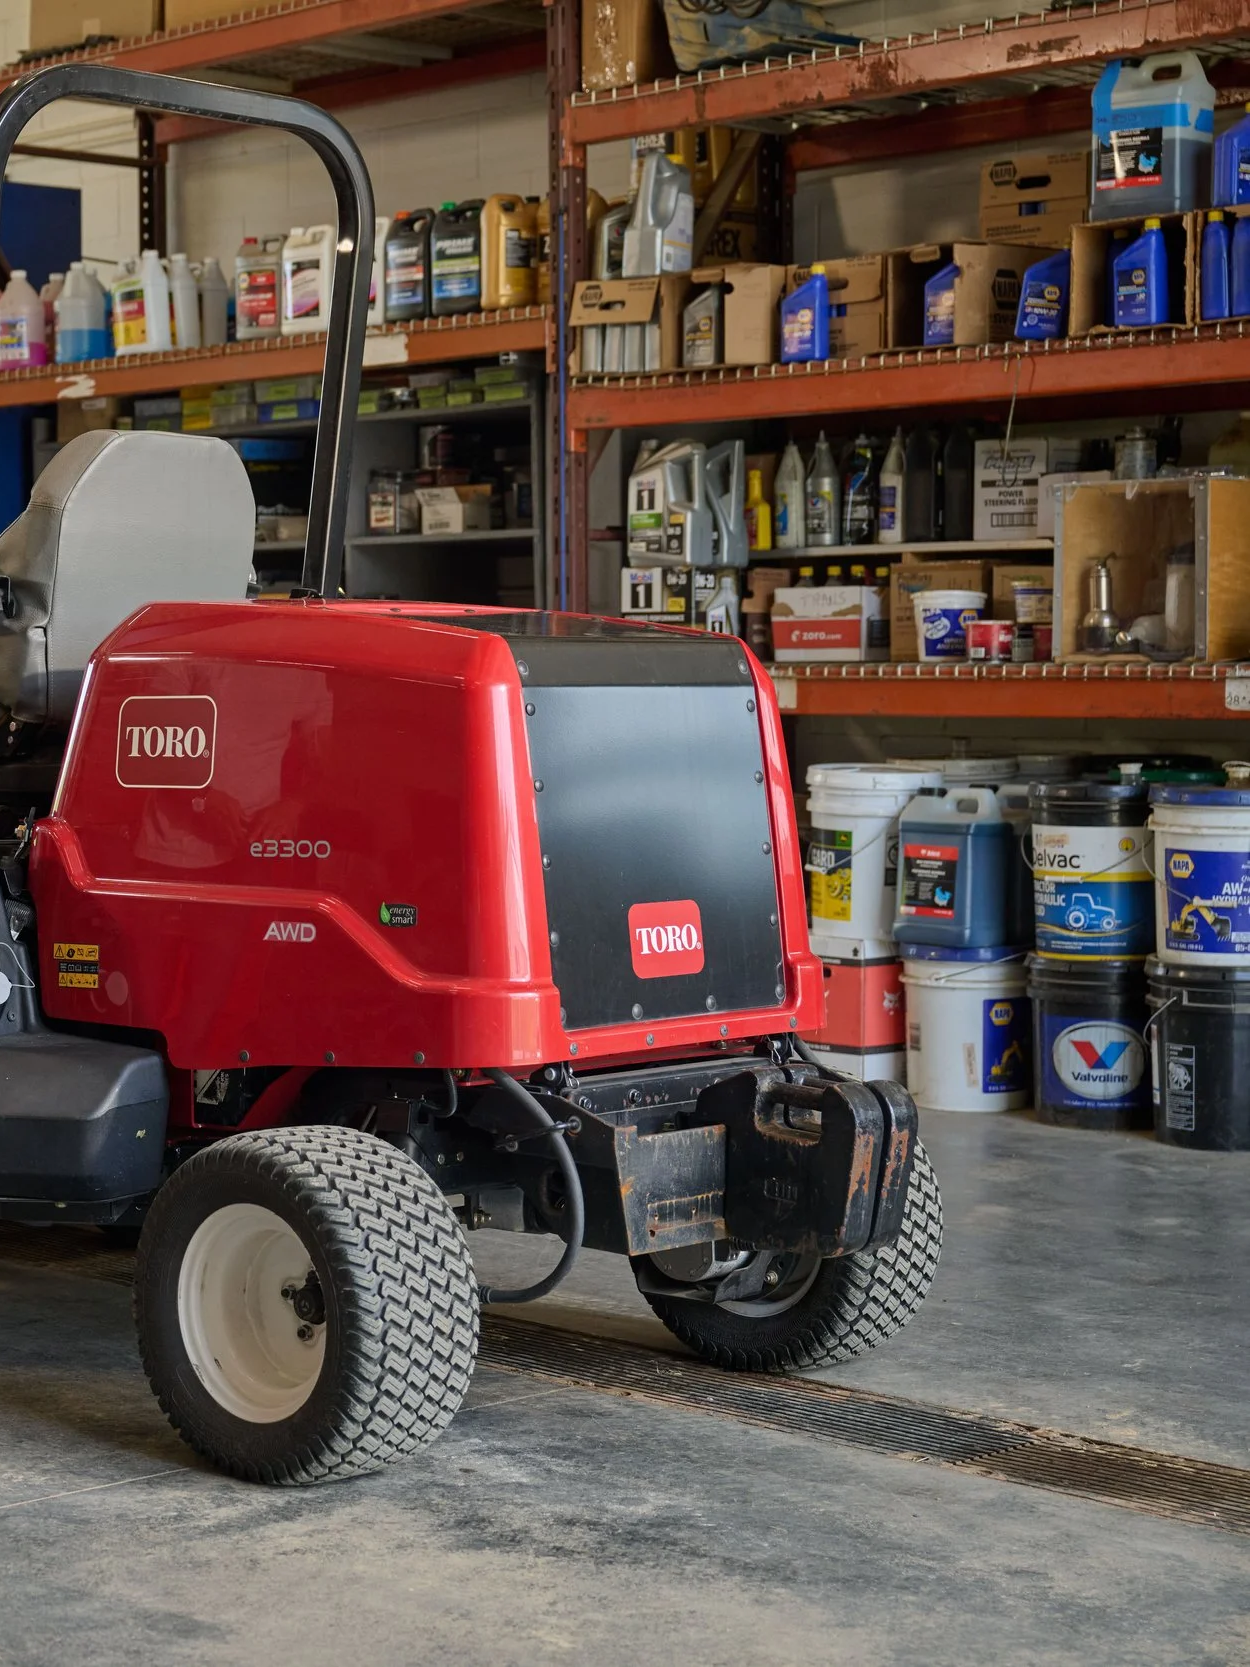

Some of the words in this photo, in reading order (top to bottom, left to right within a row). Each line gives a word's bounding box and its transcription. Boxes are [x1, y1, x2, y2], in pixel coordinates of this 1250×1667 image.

[641, 490, 649, 510] 1
[998, 490, 1023, 498] POWER
[984, 499, 1016, 507] STEERING
[636, 584, 646, 608] 1
[800, 591, 847, 607] TRANS
[802, 631, 842, 640] zoro.com
[125, 726, 206, 758] TORO
[250, 839, 331, 859] e3300
[1173, 860, 1190, 872] NAPA
[1221, 882, 1250, 896] AW-
[389, 905, 416, 917] energy
[391, 915, 414, 925] smart
[263, 921, 316, 942] AWD
[635, 923, 698, 955] TORO
[1072, 1072, 1128, 1083] Valvoline
